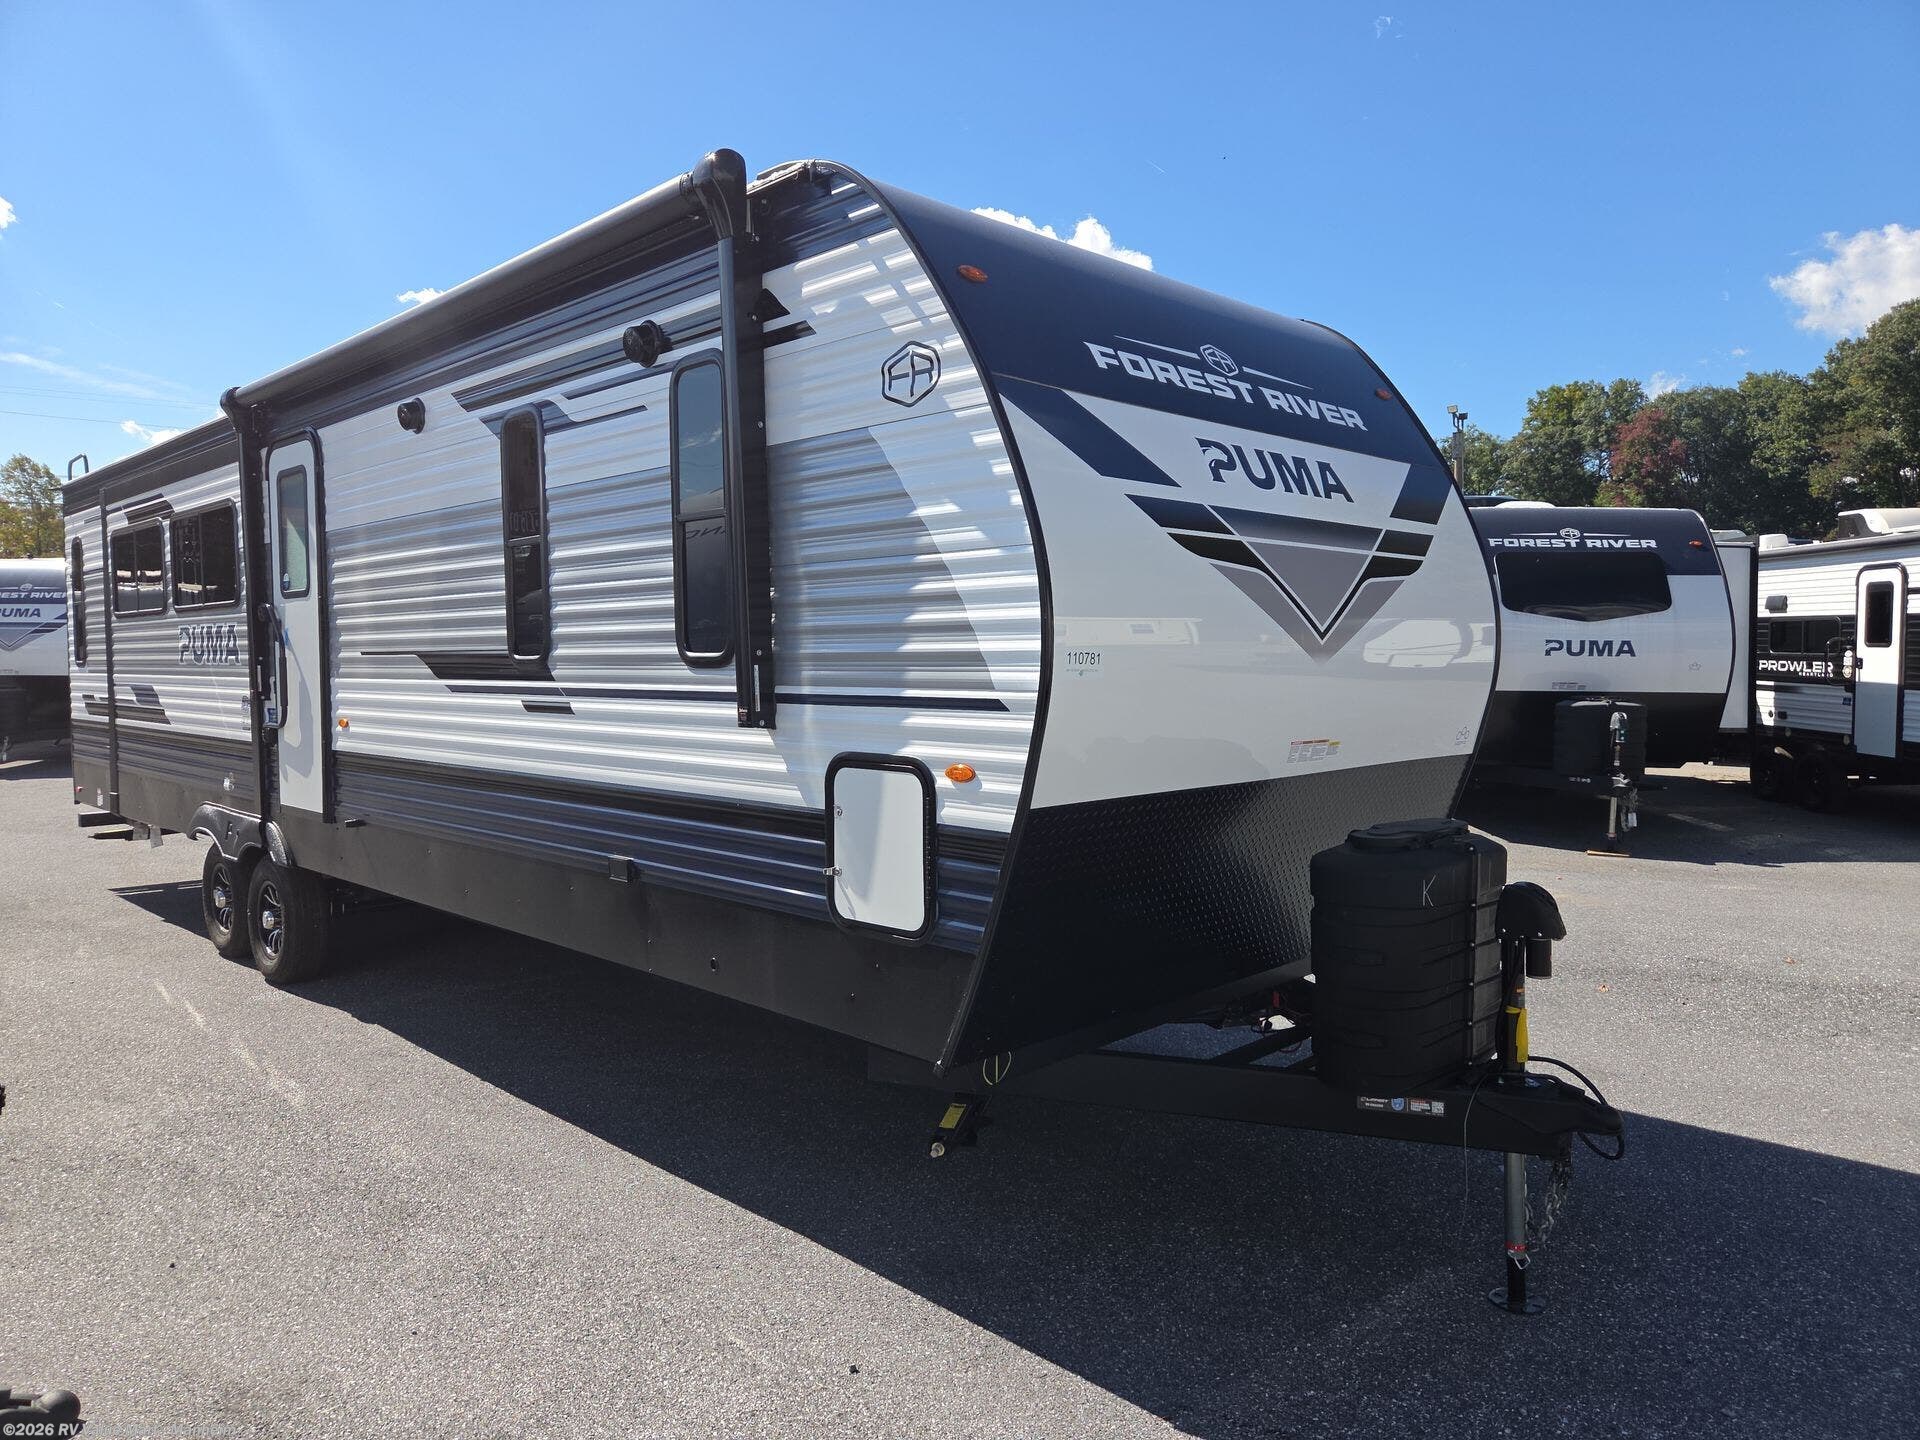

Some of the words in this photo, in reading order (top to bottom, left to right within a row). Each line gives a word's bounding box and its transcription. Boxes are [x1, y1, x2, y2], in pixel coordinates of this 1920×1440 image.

[1083, 341, 1254, 404] FOREST
[1258, 386, 1368, 431] RIVER
[1195, 437, 1354, 503] PUMA
[1488, 538, 1580, 548] FOREST
[1585, 539, 1658, 548] RIVER
[0, 591, 28, 599] EST
[0, 607, 41, 618] UMA
[178, 622, 241, 665] PUMA
[1544, 639, 1636, 657] PUMA
[1067, 651, 1101, 665] 110781
[1758, 660, 1834, 673] PROWLER
[1422, 874, 1437, 907] K
